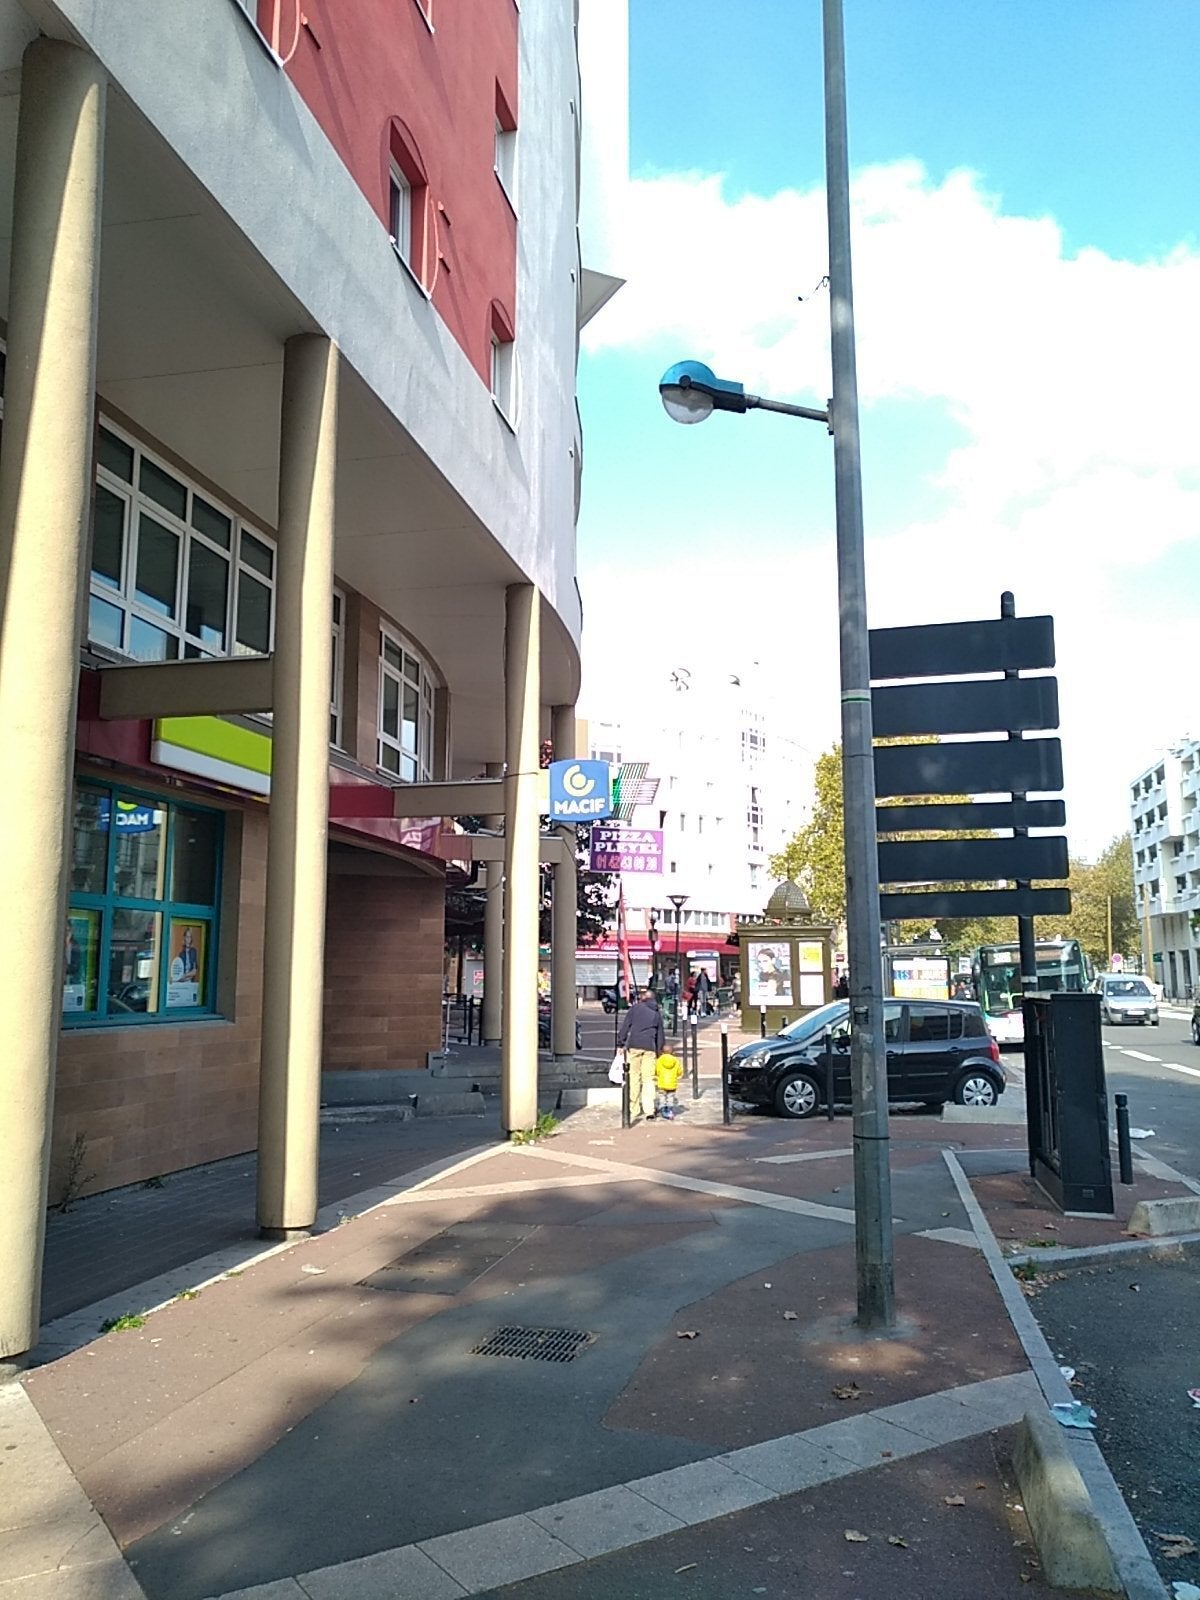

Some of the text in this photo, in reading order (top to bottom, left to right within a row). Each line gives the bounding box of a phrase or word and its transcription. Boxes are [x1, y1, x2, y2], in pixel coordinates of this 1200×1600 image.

[554, 797, 606, 815] MACIF
[600, 830, 656, 843] PIZZA
[594, 841, 662, 855] PLEYEL
[596, 854, 607, 869] 01
